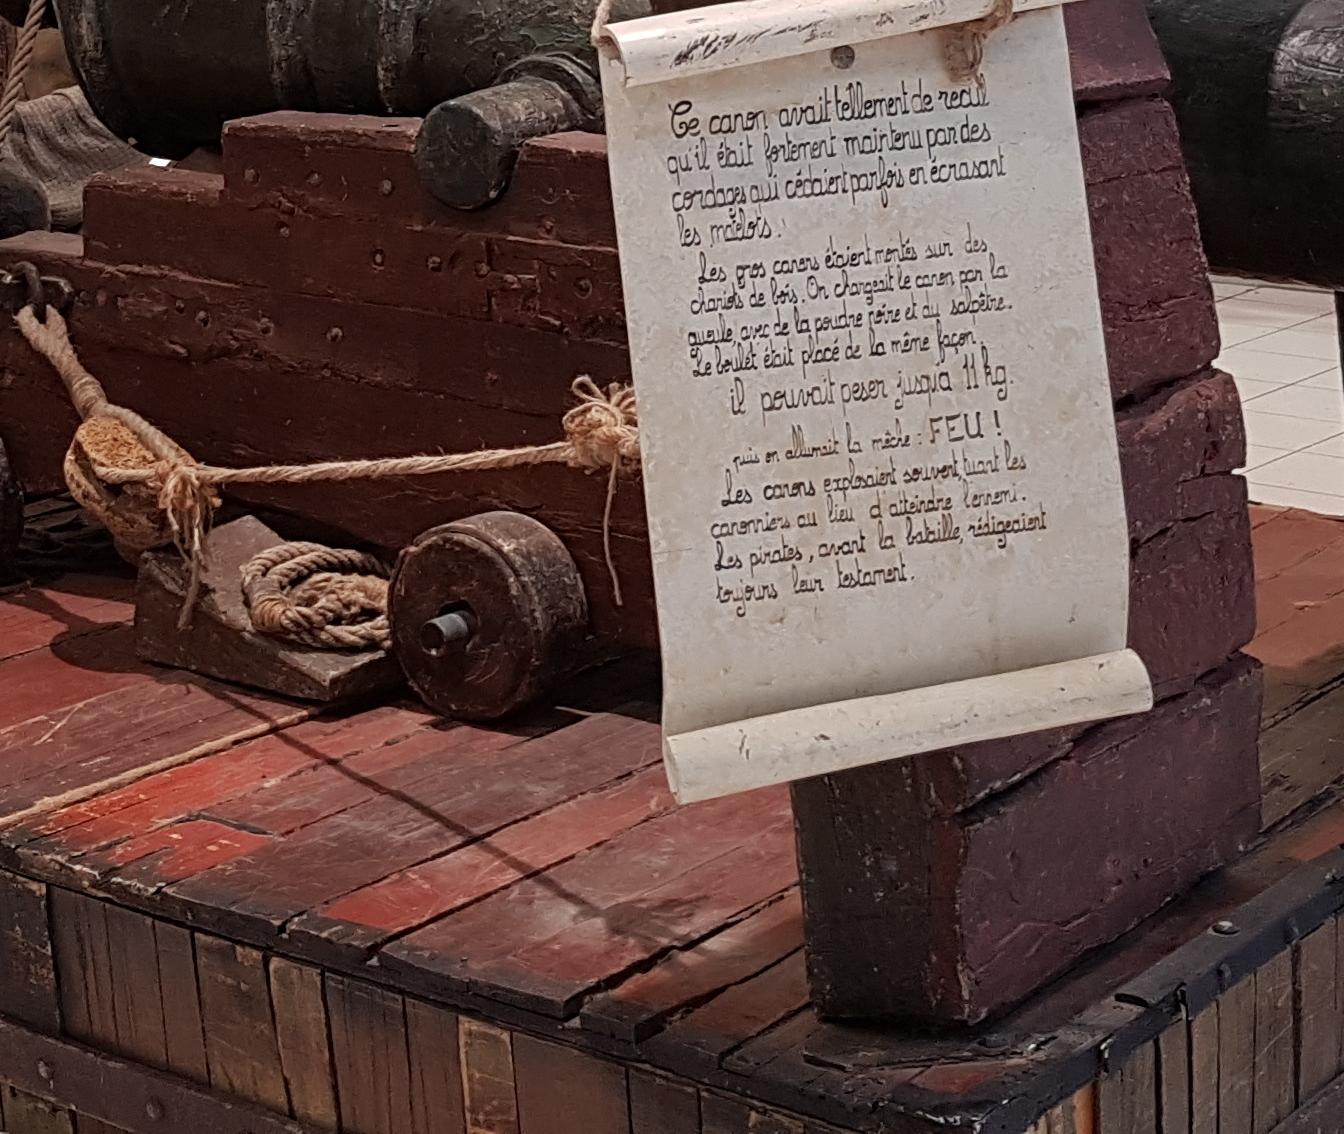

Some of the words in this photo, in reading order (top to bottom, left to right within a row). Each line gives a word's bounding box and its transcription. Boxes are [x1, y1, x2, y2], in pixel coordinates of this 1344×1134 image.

[668, 100, 702, 139] Ce
[708, 110, 769, 135] canon
[779, 87, 832, 127] avait
[834, 80, 909, 122] tellement
[911, 78, 935, 114] de
[938, 73, 990, 109] recul
[717, 135, 754, 168] était
[764, 126, 837, 178] fortement
[844, 122, 923, 157] maintenu
[927, 125, 957, 160] par
[961, 114, 992, 144] des
[672, 174, 746, 219] cordages
[750, 174, 780, 211] qui
[785, 163, 848, 199] cédaient
[850, 155, 905, 208] parfois
[909, 166, 928, 185] en
[930, 145, 1007, 183] écrasant
[677, 213, 702, 247] les
[698, 251, 727, 284] Les
[736, 261, 766, 289] gros
[773, 256, 820, 275] canons
[825, 233, 873, 269] étaient
[924, 241, 953, 260] sur
[964, 221, 988, 254] des
[749, 281, 767, 308] de
[807, 275, 829, 301] On
[897, 264, 912, 290] le
[915, 270, 955, 288] canon
[959, 269, 984, 290] par
[988, 251, 1009, 280] la
[774, 307, 790, 337] de
[794, 306, 811, 334] la
[905, 292, 917, 319] et
[764, 338, 794, 368] était
[802, 334, 840, 379] placé
[845, 330, 862, 360] de
[869, 327, 887, 358] la
[891, 331, 930, 354] même
[729, 376, 746, 416] il
[761, 369, 836, 427] pouvait
[840, 377, 889, 417] peser
[963, 352, 979, 390] 11
[846, 421, 862, 454] la
[929, 412, 984, 444] FEU
[721, 468, 753, 507] Les
[763, 480, 816, 500] canons
[823, 456, 897, 503] explosaient
[1003, 439, 1027, 471] les
[710, 512, 791, 539] canonniers
[797, 511, 818, 529] au
[827, 494, 855, 523] lieu
[714, 540, 743, 572] Les
[818, 528, 866, 558] avant
[878, 519, 895, 549] la
[716, 576, 778, 617] toujours
[791, 564, 824, 594] leur
